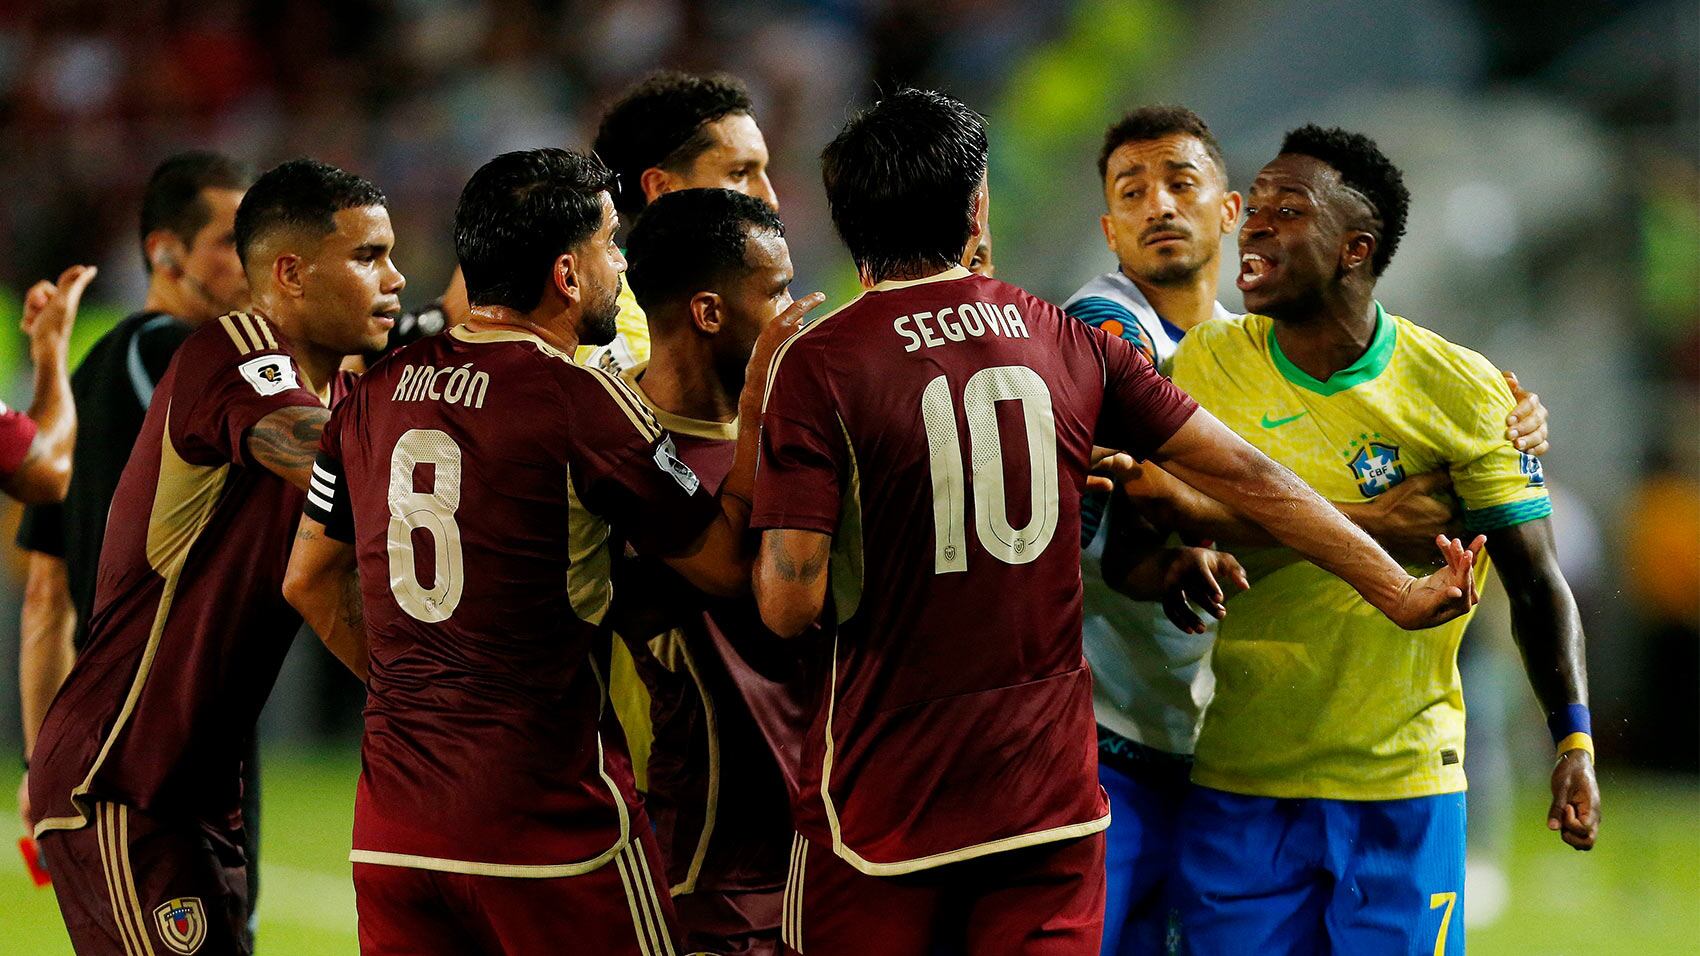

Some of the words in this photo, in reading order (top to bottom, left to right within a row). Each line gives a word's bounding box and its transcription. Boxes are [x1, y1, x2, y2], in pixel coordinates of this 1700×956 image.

[893, 301, 1030, 353] SEGOVIA
[391, 362, 490, 409] RINCÓN
[921, 365, 1059, 574] 10
[1368, 465, 1388, 478] CBF
[387, 428, 464, 623] 8
[1430, 891, 1457, 956] 7
